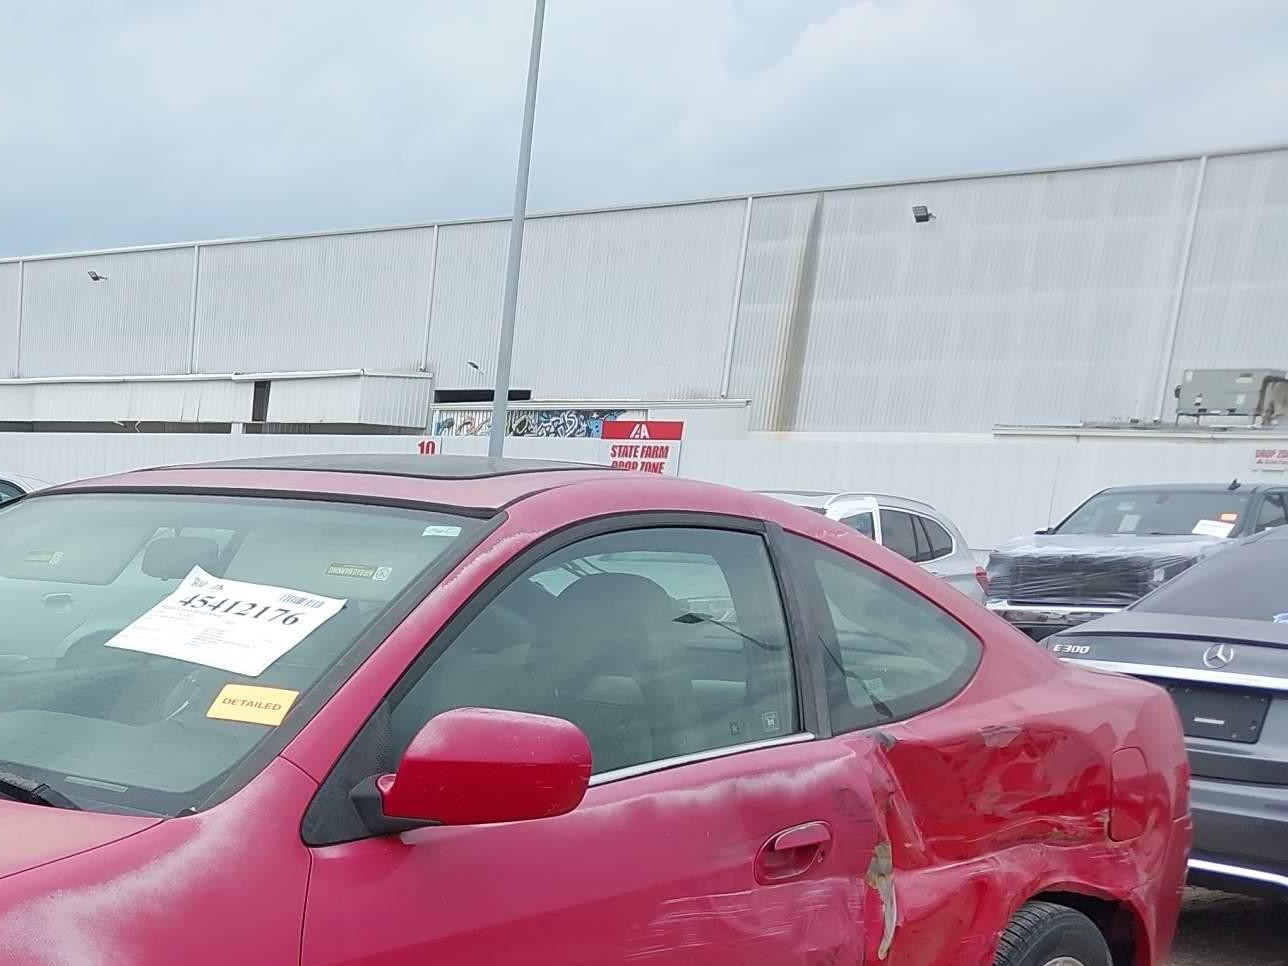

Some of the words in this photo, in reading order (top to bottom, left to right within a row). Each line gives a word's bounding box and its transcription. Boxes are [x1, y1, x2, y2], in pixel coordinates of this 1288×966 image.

[610, 444, 640, 458] STATE
[640, 445, 669, 459] FARM
[639, 461, 665, 474] ZONE
[179, 593, 305, 626] 45412176
[1053, 644, 1063, 652] E
[1063, 644, 1091, 654] 300
[222, 697, 282, 711] DETAILED
